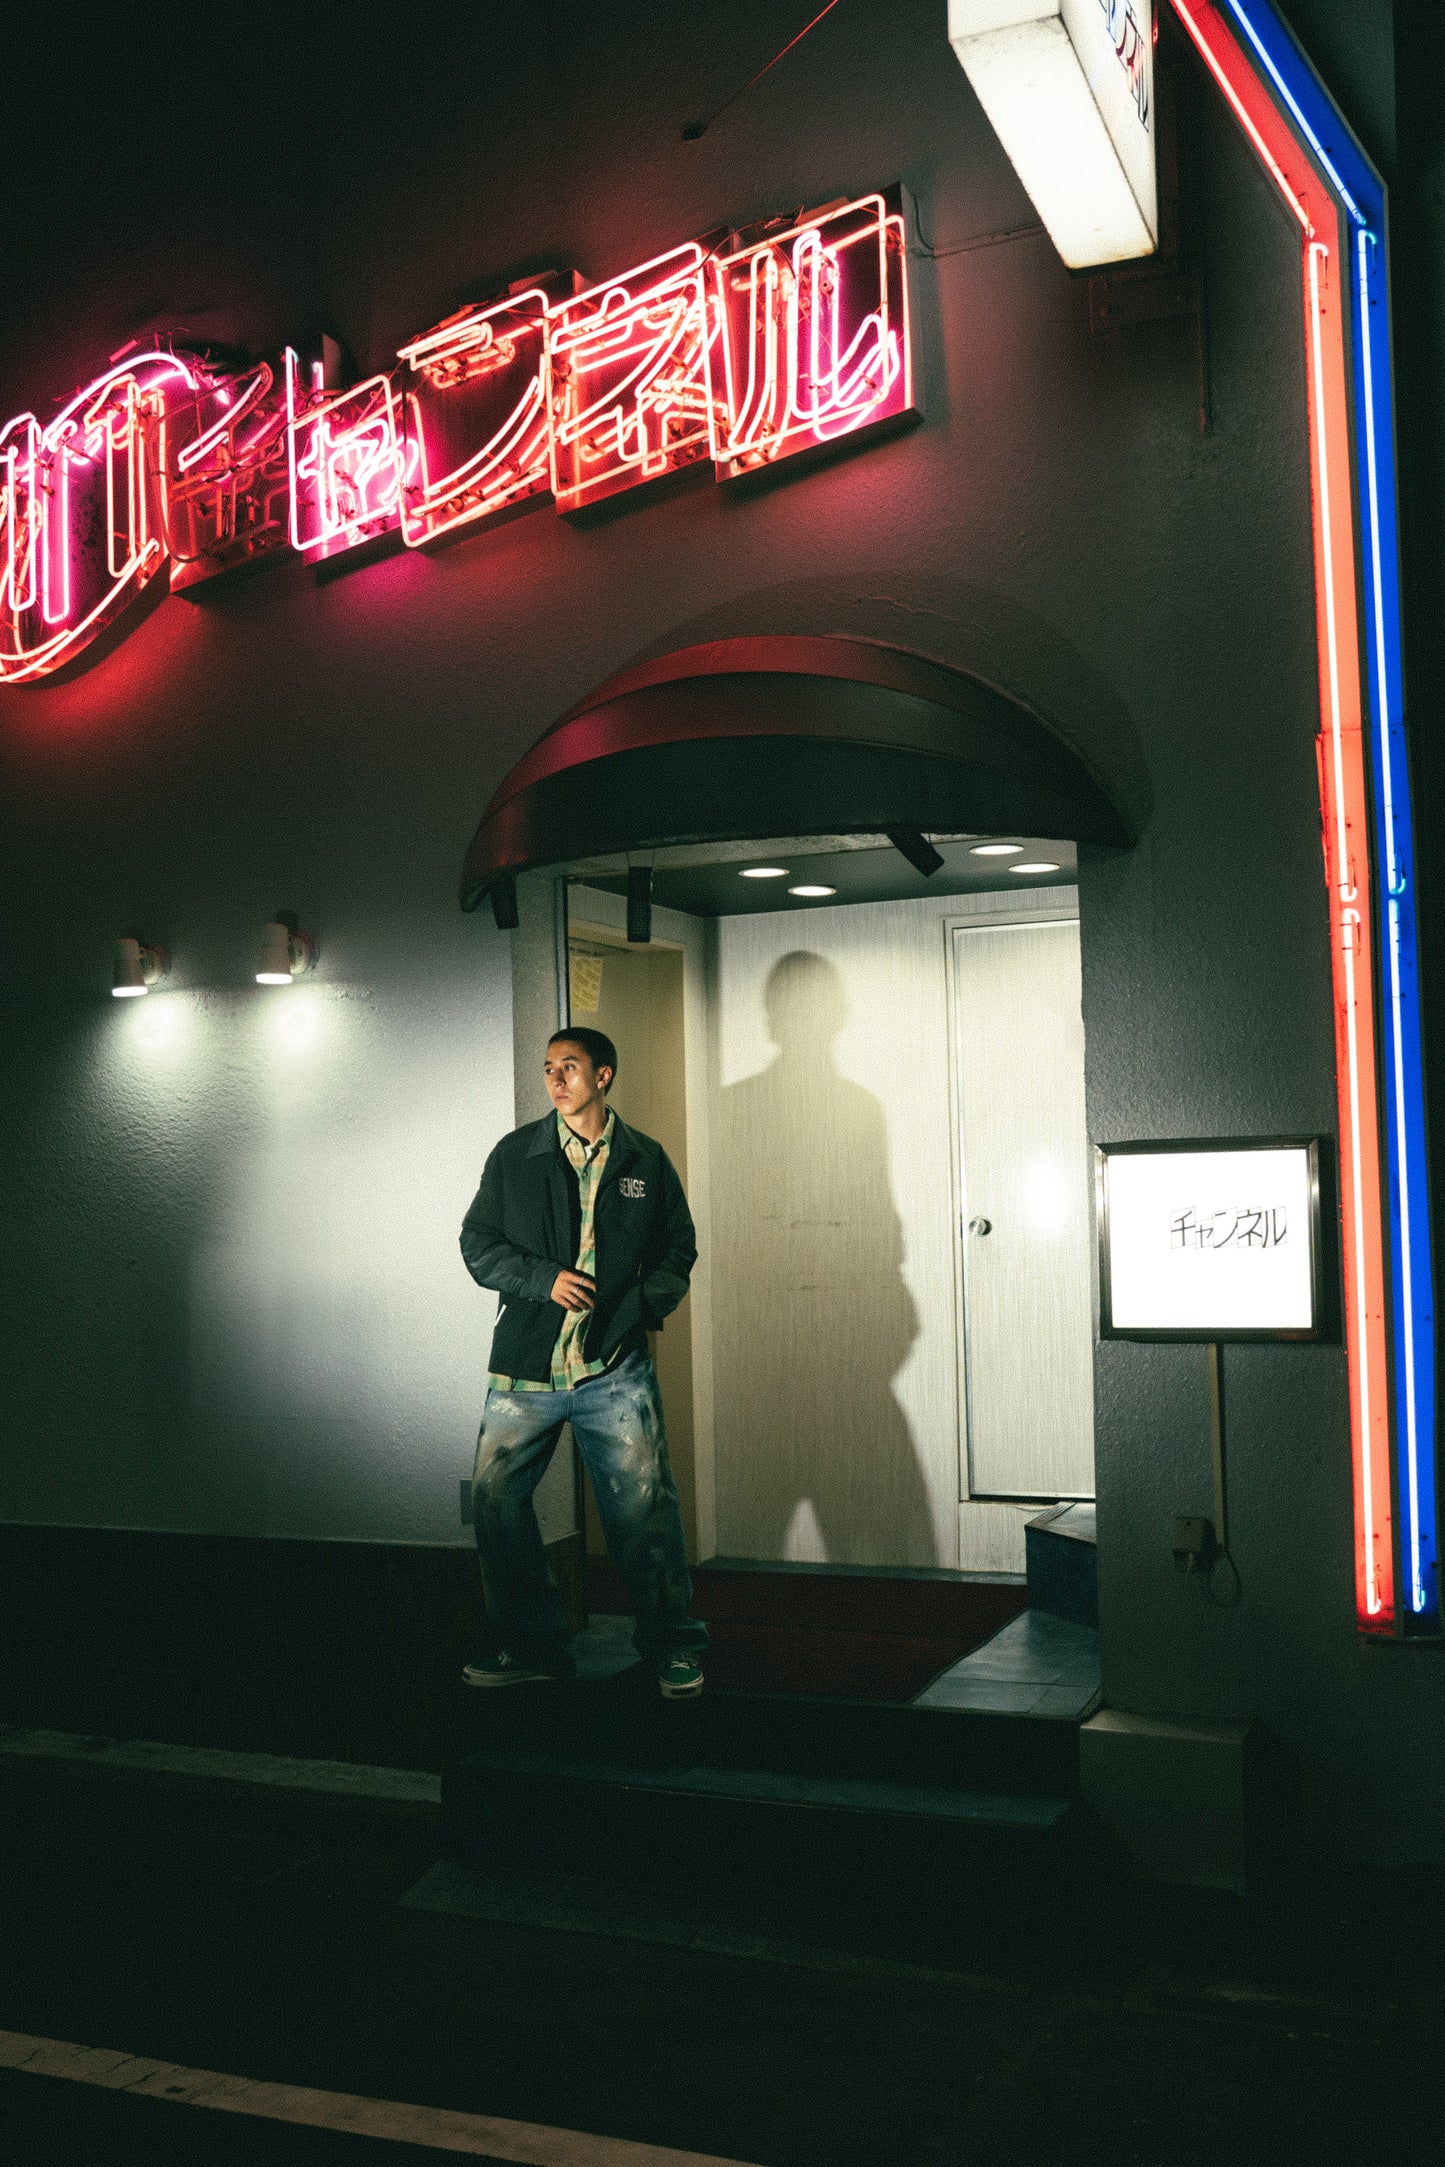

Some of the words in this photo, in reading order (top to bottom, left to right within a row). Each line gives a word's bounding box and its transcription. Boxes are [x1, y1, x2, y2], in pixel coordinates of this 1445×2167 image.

[619, 1176, 646, 1199] SENSE
[1170, 1207, 1287, 1249] チャンネル
